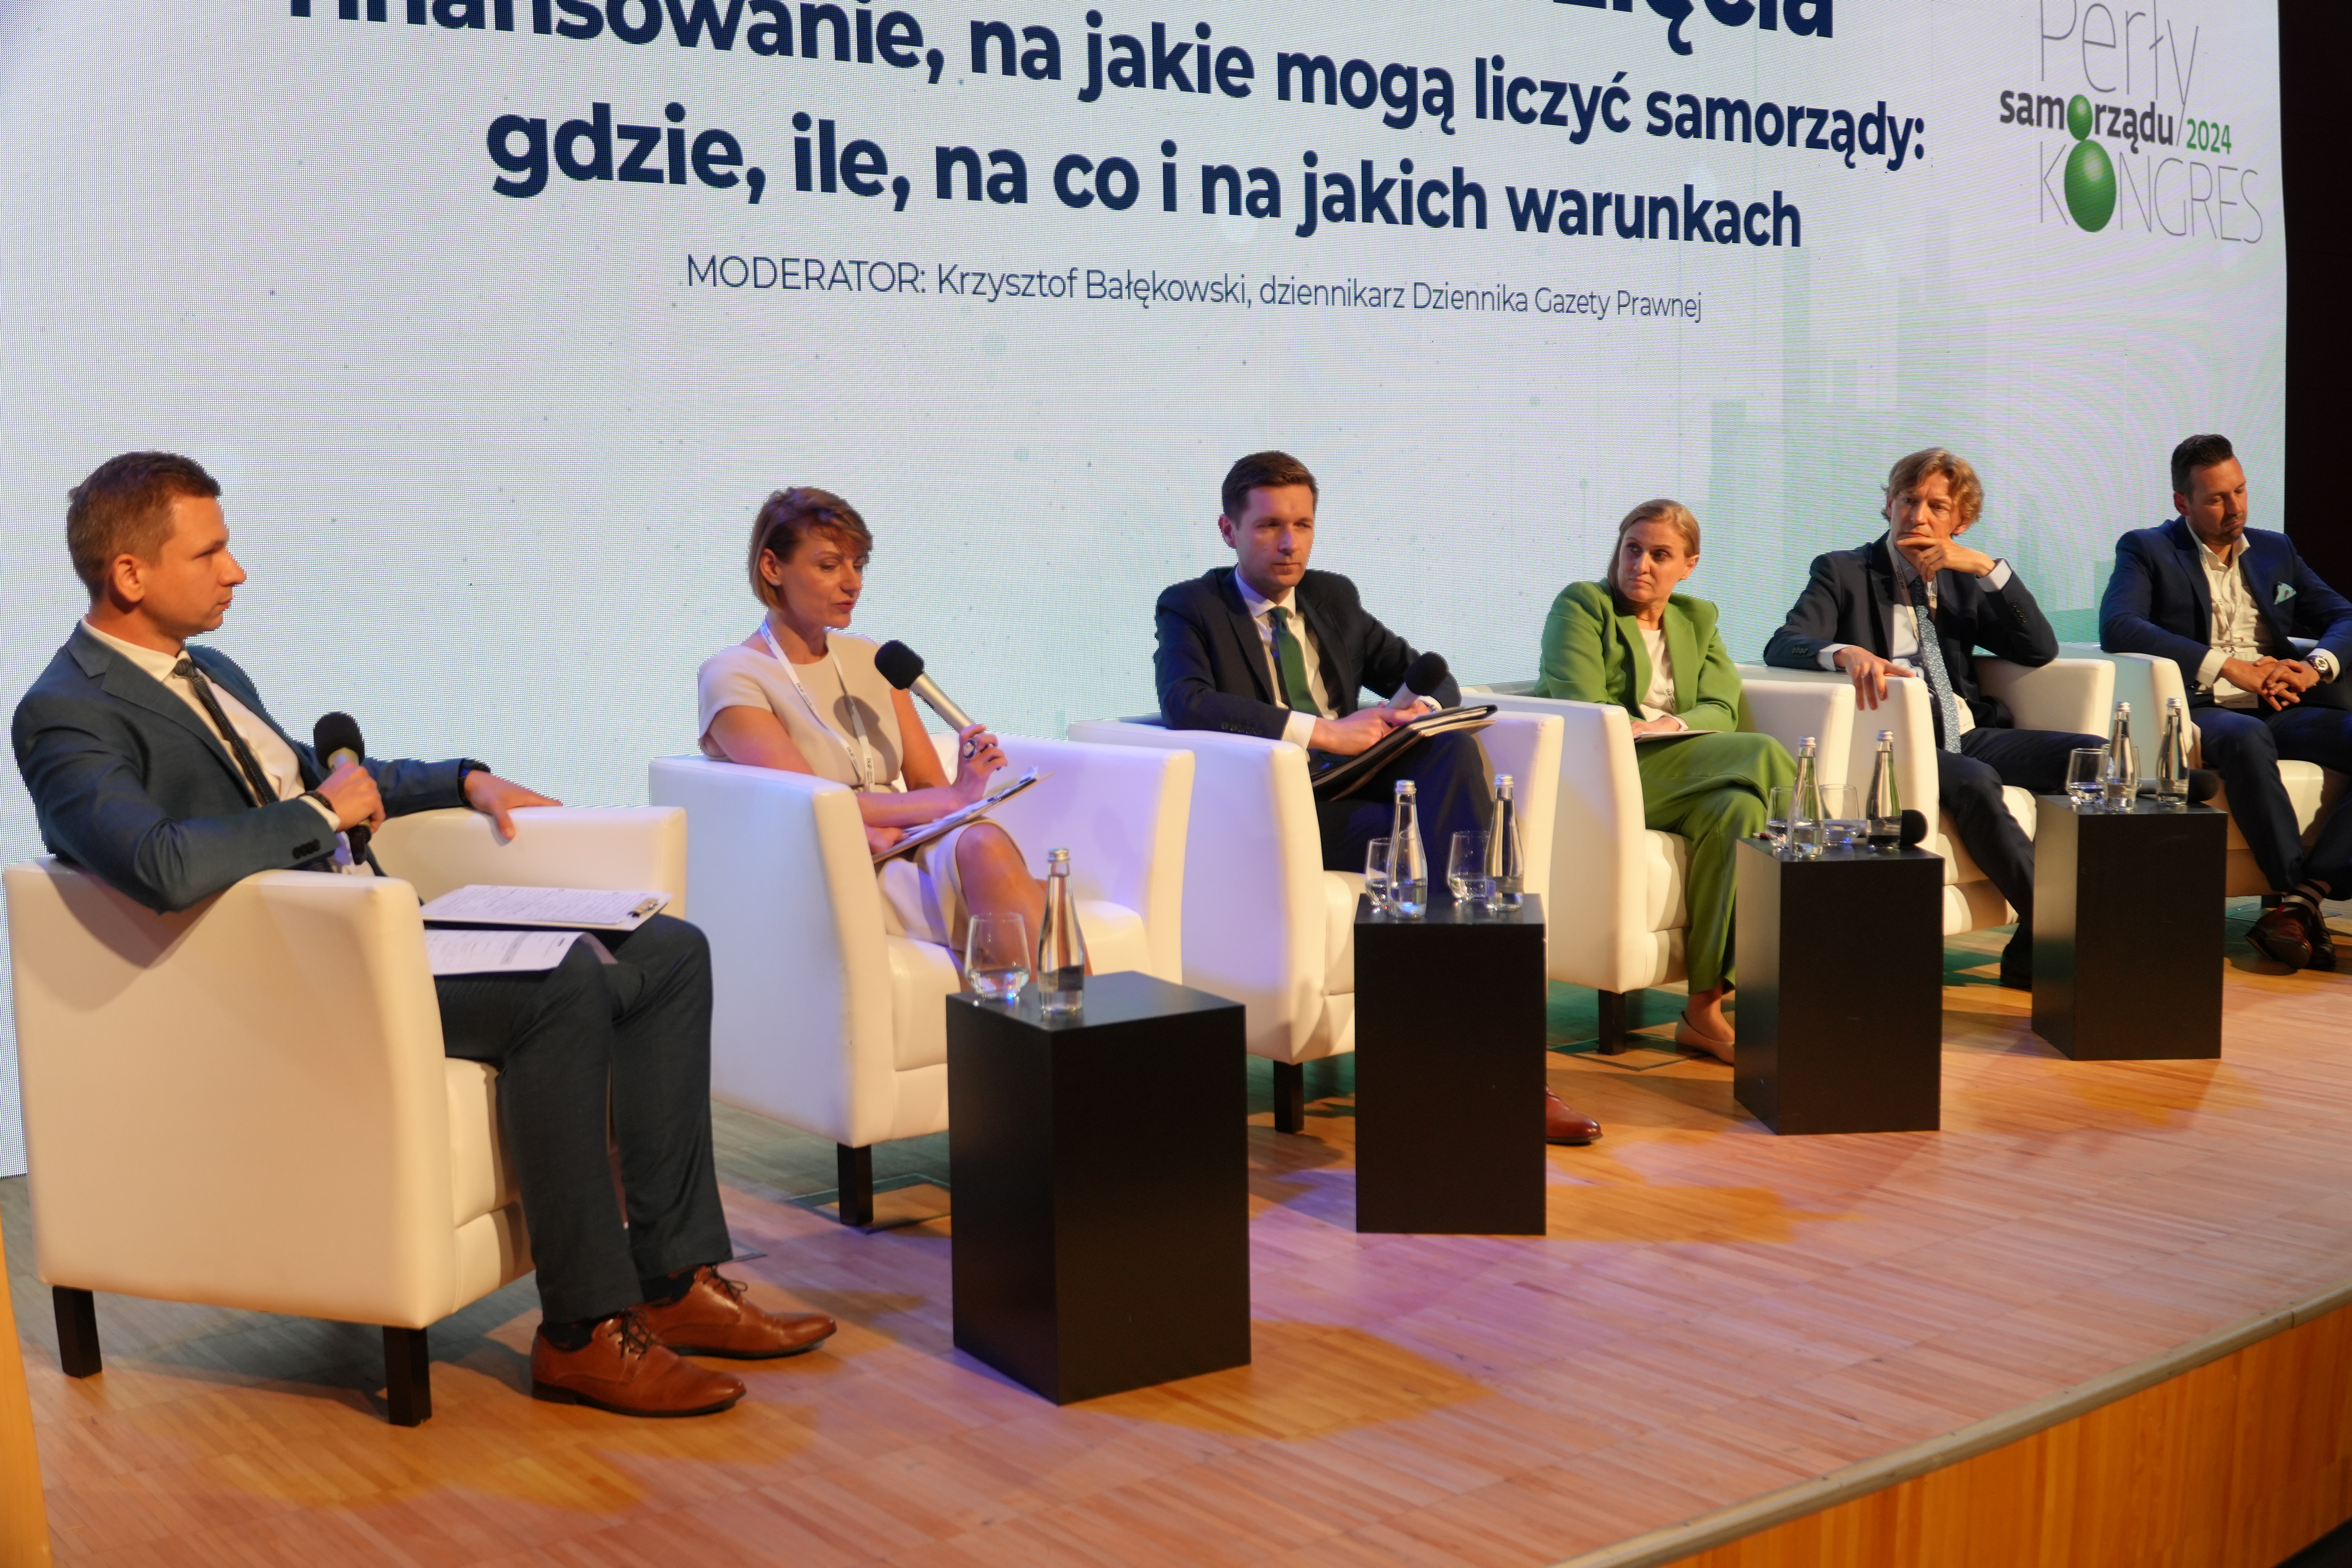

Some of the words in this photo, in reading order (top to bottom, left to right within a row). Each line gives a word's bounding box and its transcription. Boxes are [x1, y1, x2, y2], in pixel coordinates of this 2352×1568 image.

[291, 0, 944, 84] ansowanie,
[971, 21, 1060, 80] na
[1078, 10, 1254, 102] jakie
[1278, 53, 1454, 135] mogą
[1476, 55, 1630, 144] liczyć
[1647, 92, 1924, 171] samorządy:
[2186, 119, 2232, 154] 2024
[487, 103, 765, 204] gdzie,
[792, 112, 909, 211] ile,
[936, 147, 1027, 204] na
[1054, 155, 1139, 210] co
[1161, 140, 1176, 211] i
[1202, 165, 1280, 218] na
[1296, 151, 1486, 237] jakich
[1506, 185, 1800, 247] warunkach
[687, 254, 925, 293] MODERATOR:
[937, 264, 1078, 303] Krzysztof
[1086, 269, 1252, 309] Bałękowski,
[1259, 275, 1405, 309] dziennikarz
[1413, 281, 1528, 313] Dziennika
[1534, 286, 1611, 321] Gazety
[1616, 289, 1702, 324] Prawnej
